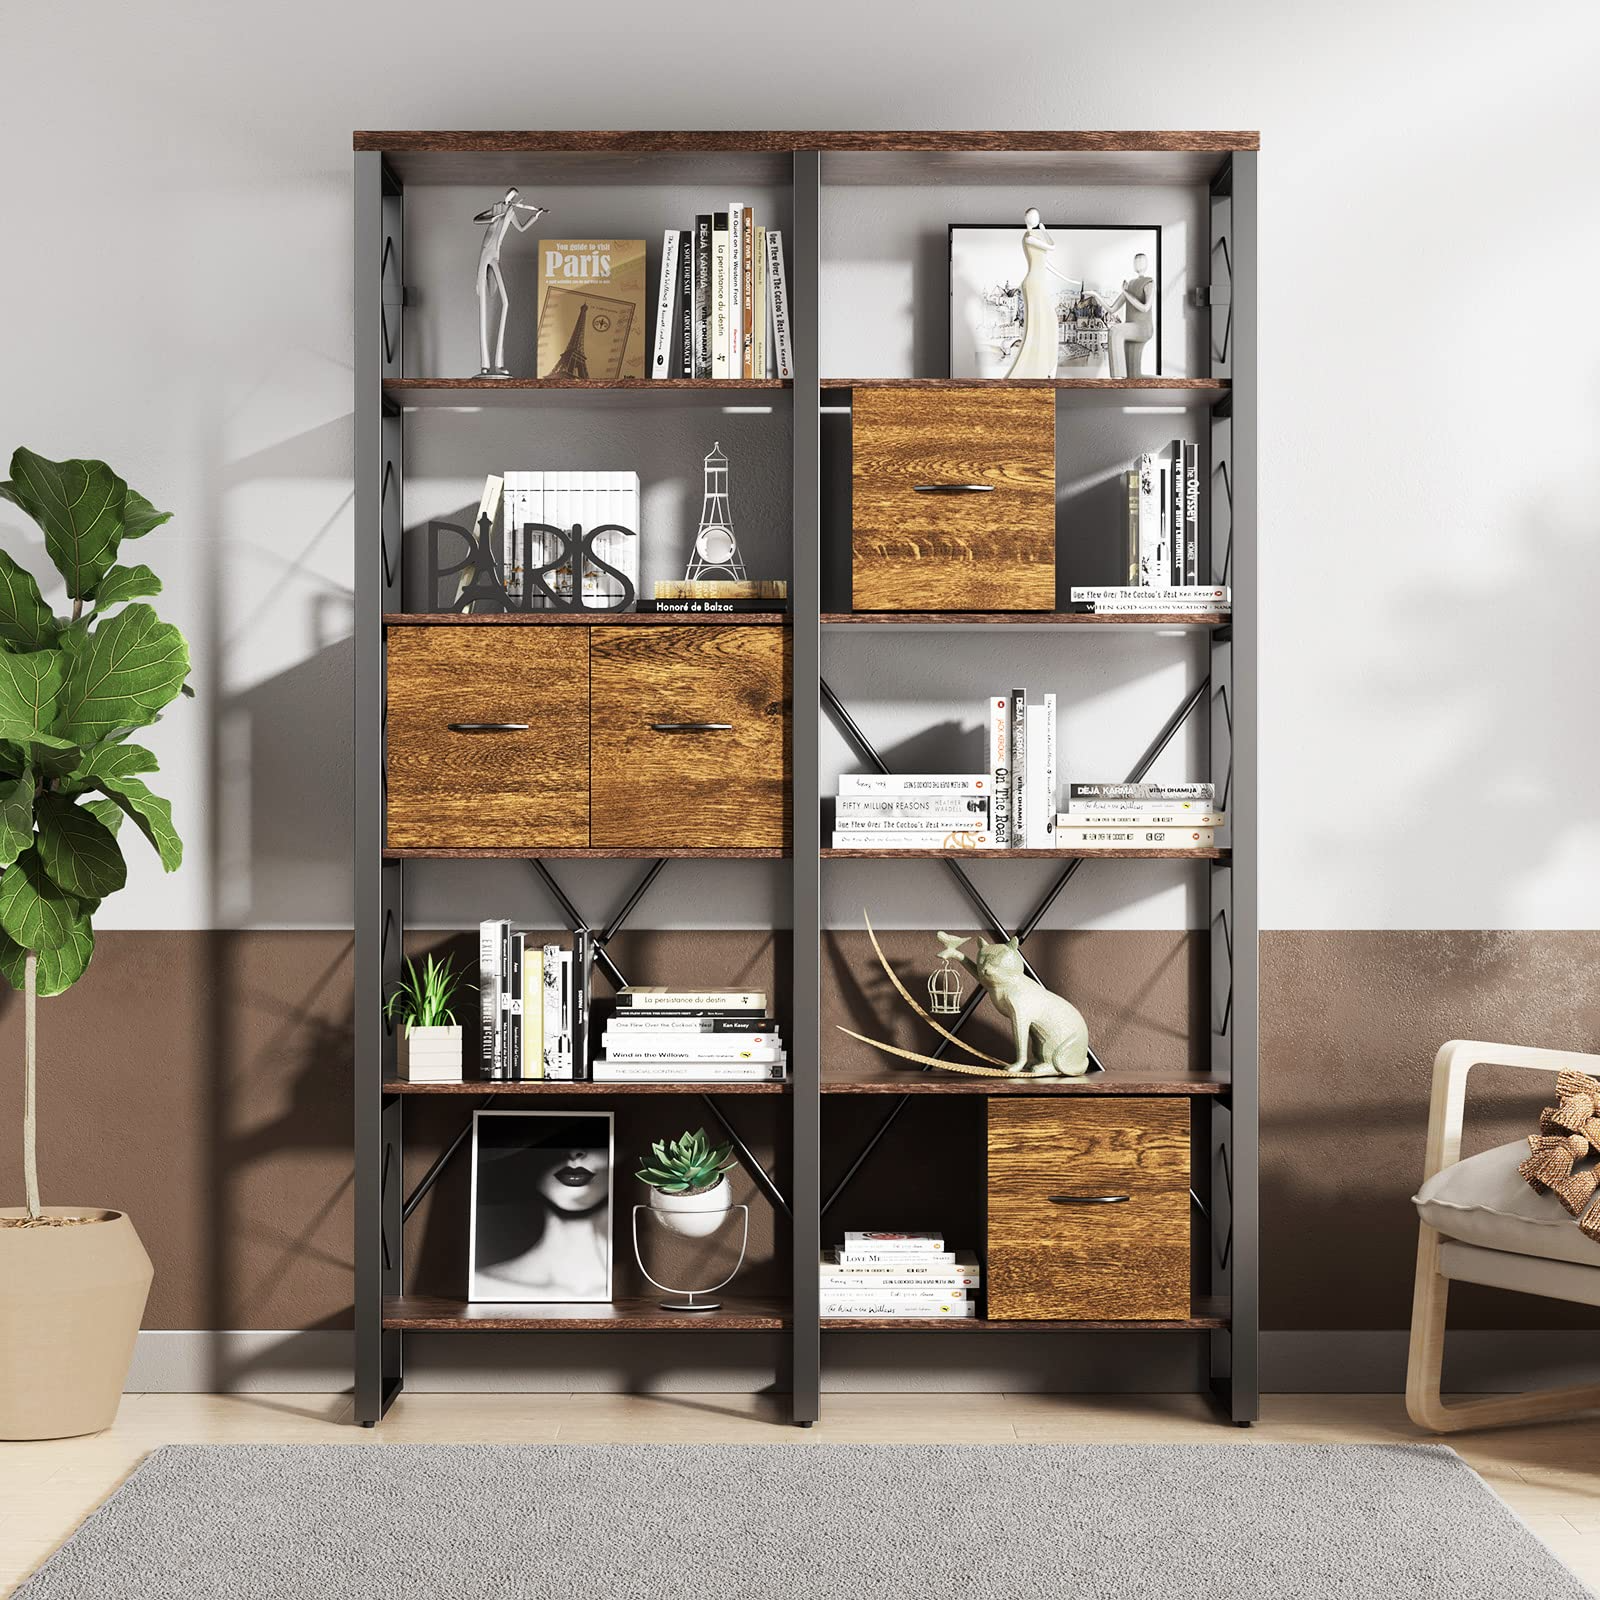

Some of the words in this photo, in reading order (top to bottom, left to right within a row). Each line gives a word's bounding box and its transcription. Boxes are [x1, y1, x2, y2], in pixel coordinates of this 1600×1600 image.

[733, 239, 738, 248] on
[769, 233, 778, 245] One
[717, 244, 726, 254] La
[770, 246, 779, 261] Flew
[544, 250, 611, 278] Paris
[699, 252, 708, 289] KARMA
[772, 261, 780, 276] Over
[716, 255, 726, 299] persistance
[773, 277, 782, 290] The
[718, 301, 726, 312] du
[1187, 466, 1196, 478] The
[1186, 479, 1200, 522] Odyssey
[428, 512, 637, 612] PARIS
[1086, 590, 1102, 599] Flew
[1103, 590, 1118, 599] Over
[1119, 590, 1132, 599] The
[656, 601, 689, 612] Honoré
[690, 601, 702, 612] de
[703, 601, 734, 612] Balzac
[995, 767, 1009, 784] On
[1102, 786, 1134, 795] KARMA
[842, 801, 861, 810] FIFTY
[863, 801, 894, 810] MILLION
[895, 801, 930, 810] REASONS
[995, 787, 1009, 811] The
[995, 814, 1009, 844] Road
[481, 939, 493, 963] EXILE
